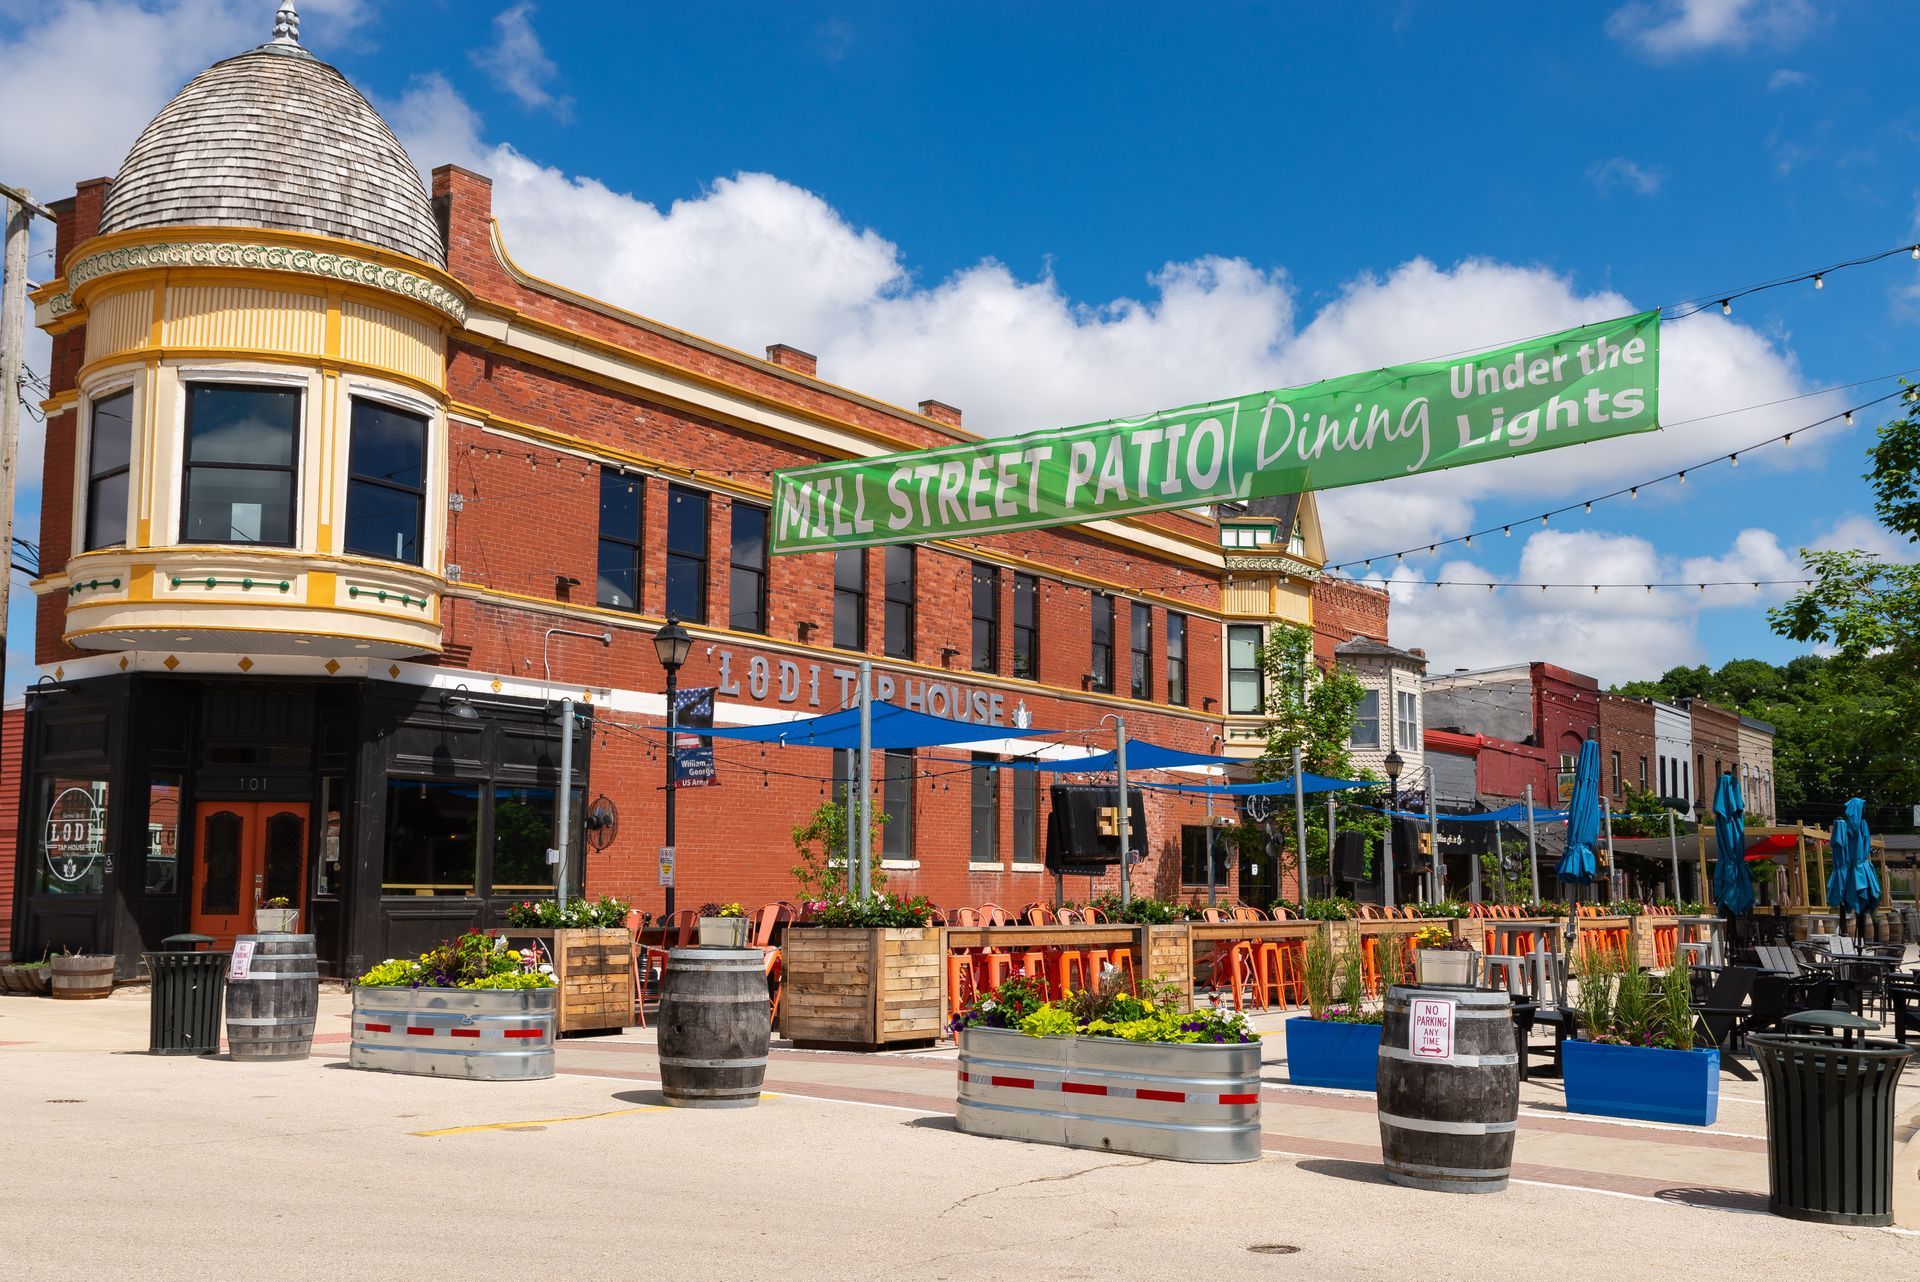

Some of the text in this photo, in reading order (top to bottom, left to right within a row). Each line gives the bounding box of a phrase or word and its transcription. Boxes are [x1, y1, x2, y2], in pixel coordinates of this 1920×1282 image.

[1450, 336, 1646, 399] Under the
[1456, 386, 1646, 448] Lights
[1256, 396, 1430, 472] Dining
[779, 417, 1225, 541] MILL STREET PATIO
[718, 650, 821, 707] LODI
[905, 679, 1004, 727] HOUSE
[680, 759, 706, 768] William
[688, 768, 715, 777] George
[240, 777, 267, 791] 101
[682, 779, 691, 787] US
[51, 822, 93, 842] LODI
[57, 843, 86, 852] TAP HOUSE
[1425, 1004, 1439, 1016] NO
[1416, 1015, 1447, 1028] PARKING
[1423, 1028, 1439, 1037] ANY
[1422, 1036, 1440, 1046] TIME
